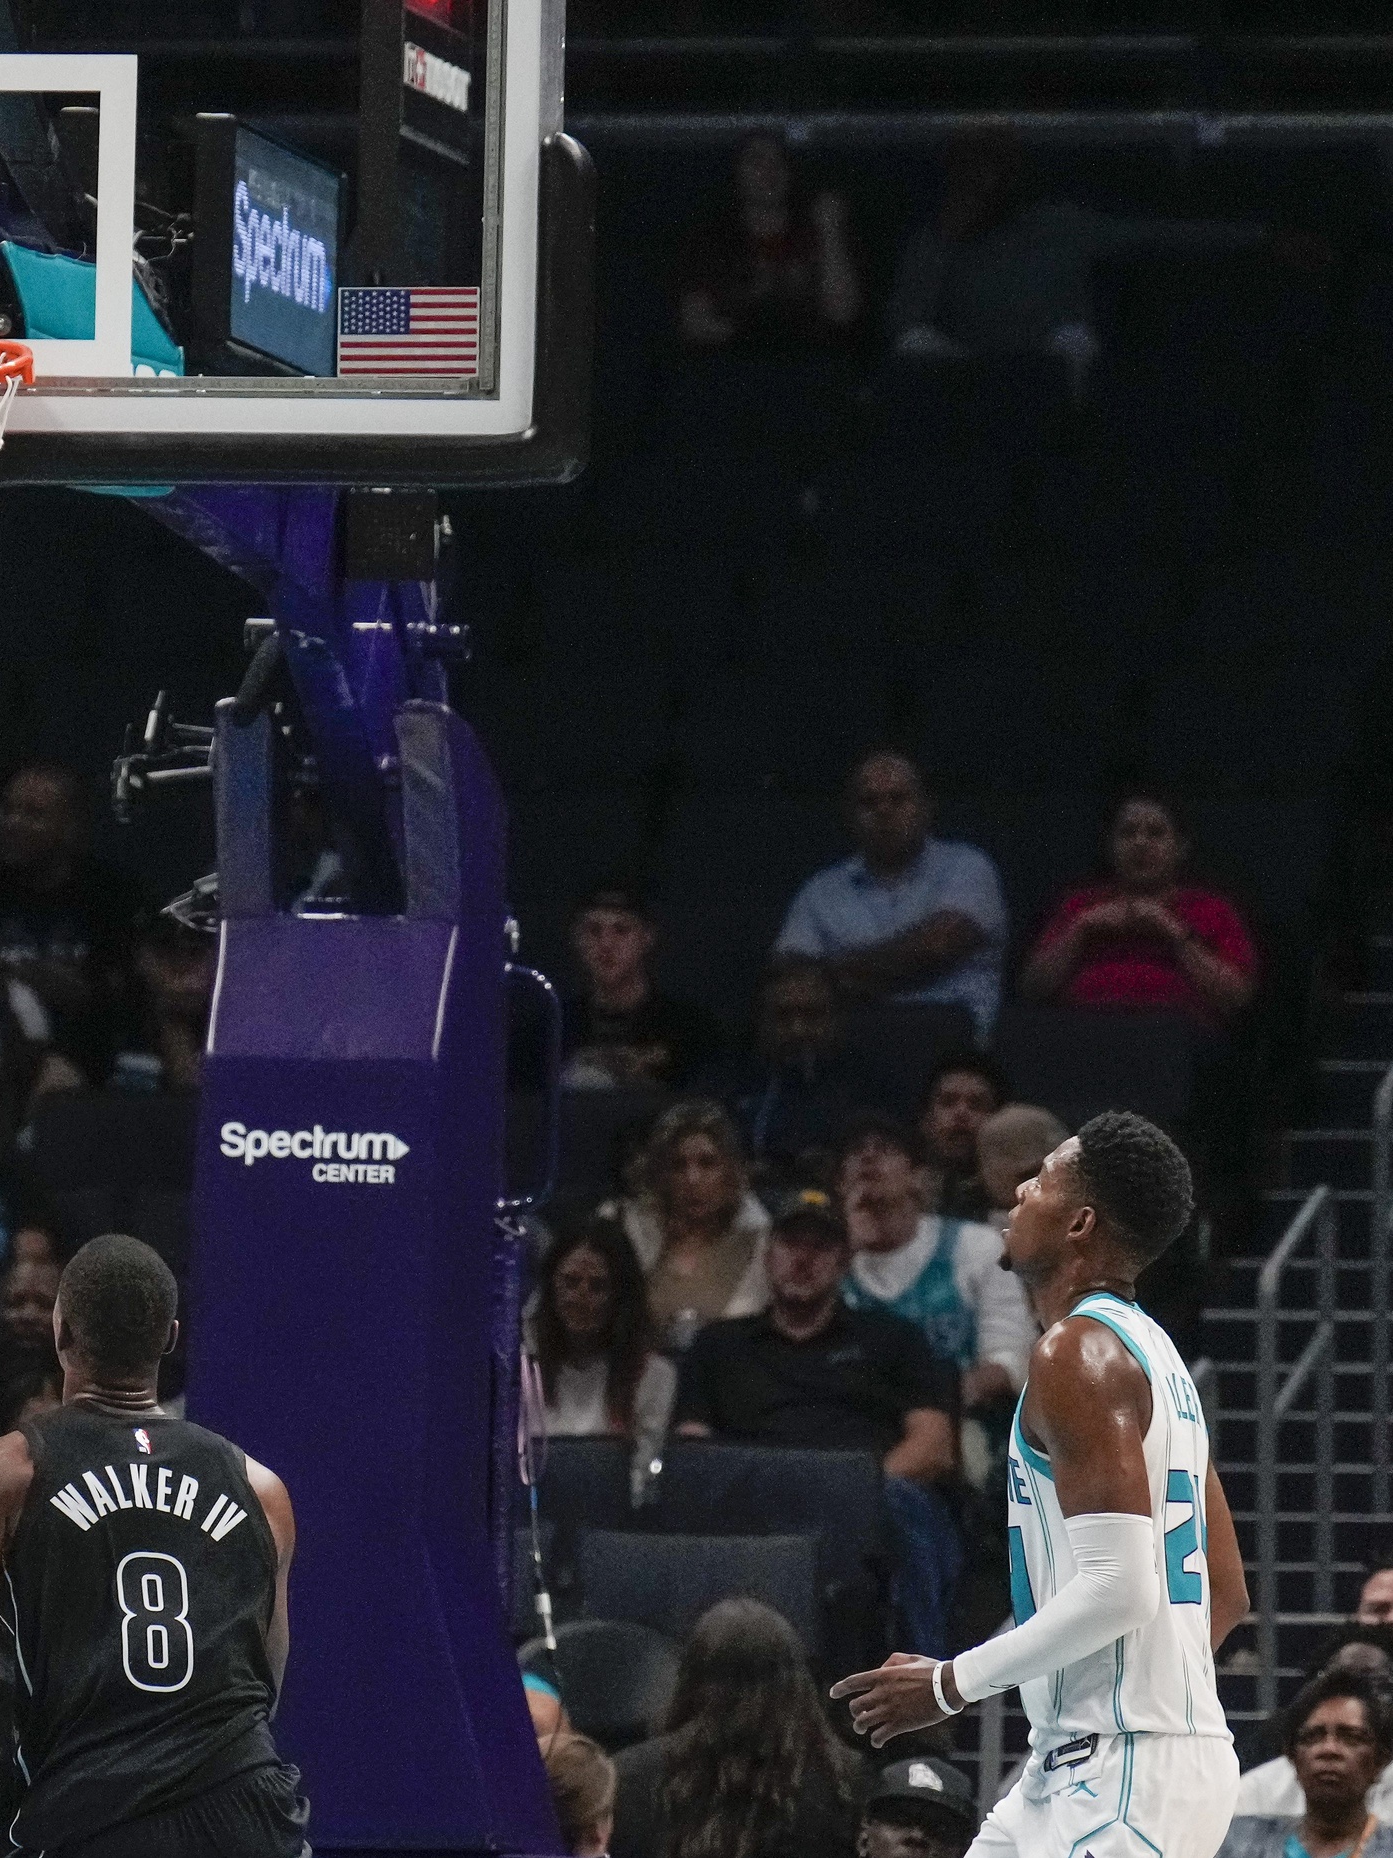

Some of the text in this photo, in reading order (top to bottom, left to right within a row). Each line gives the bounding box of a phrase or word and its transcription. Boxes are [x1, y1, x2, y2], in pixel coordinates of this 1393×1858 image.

[232, 180, 327, 314] Spectrum
[219, 1121, 397, 1167] Spectrum
[312, 1162, 396, 1184] CENTER
[49, 1463, 249, 1543] WALKER IV
[116, 1551, 195, 1694] 8
